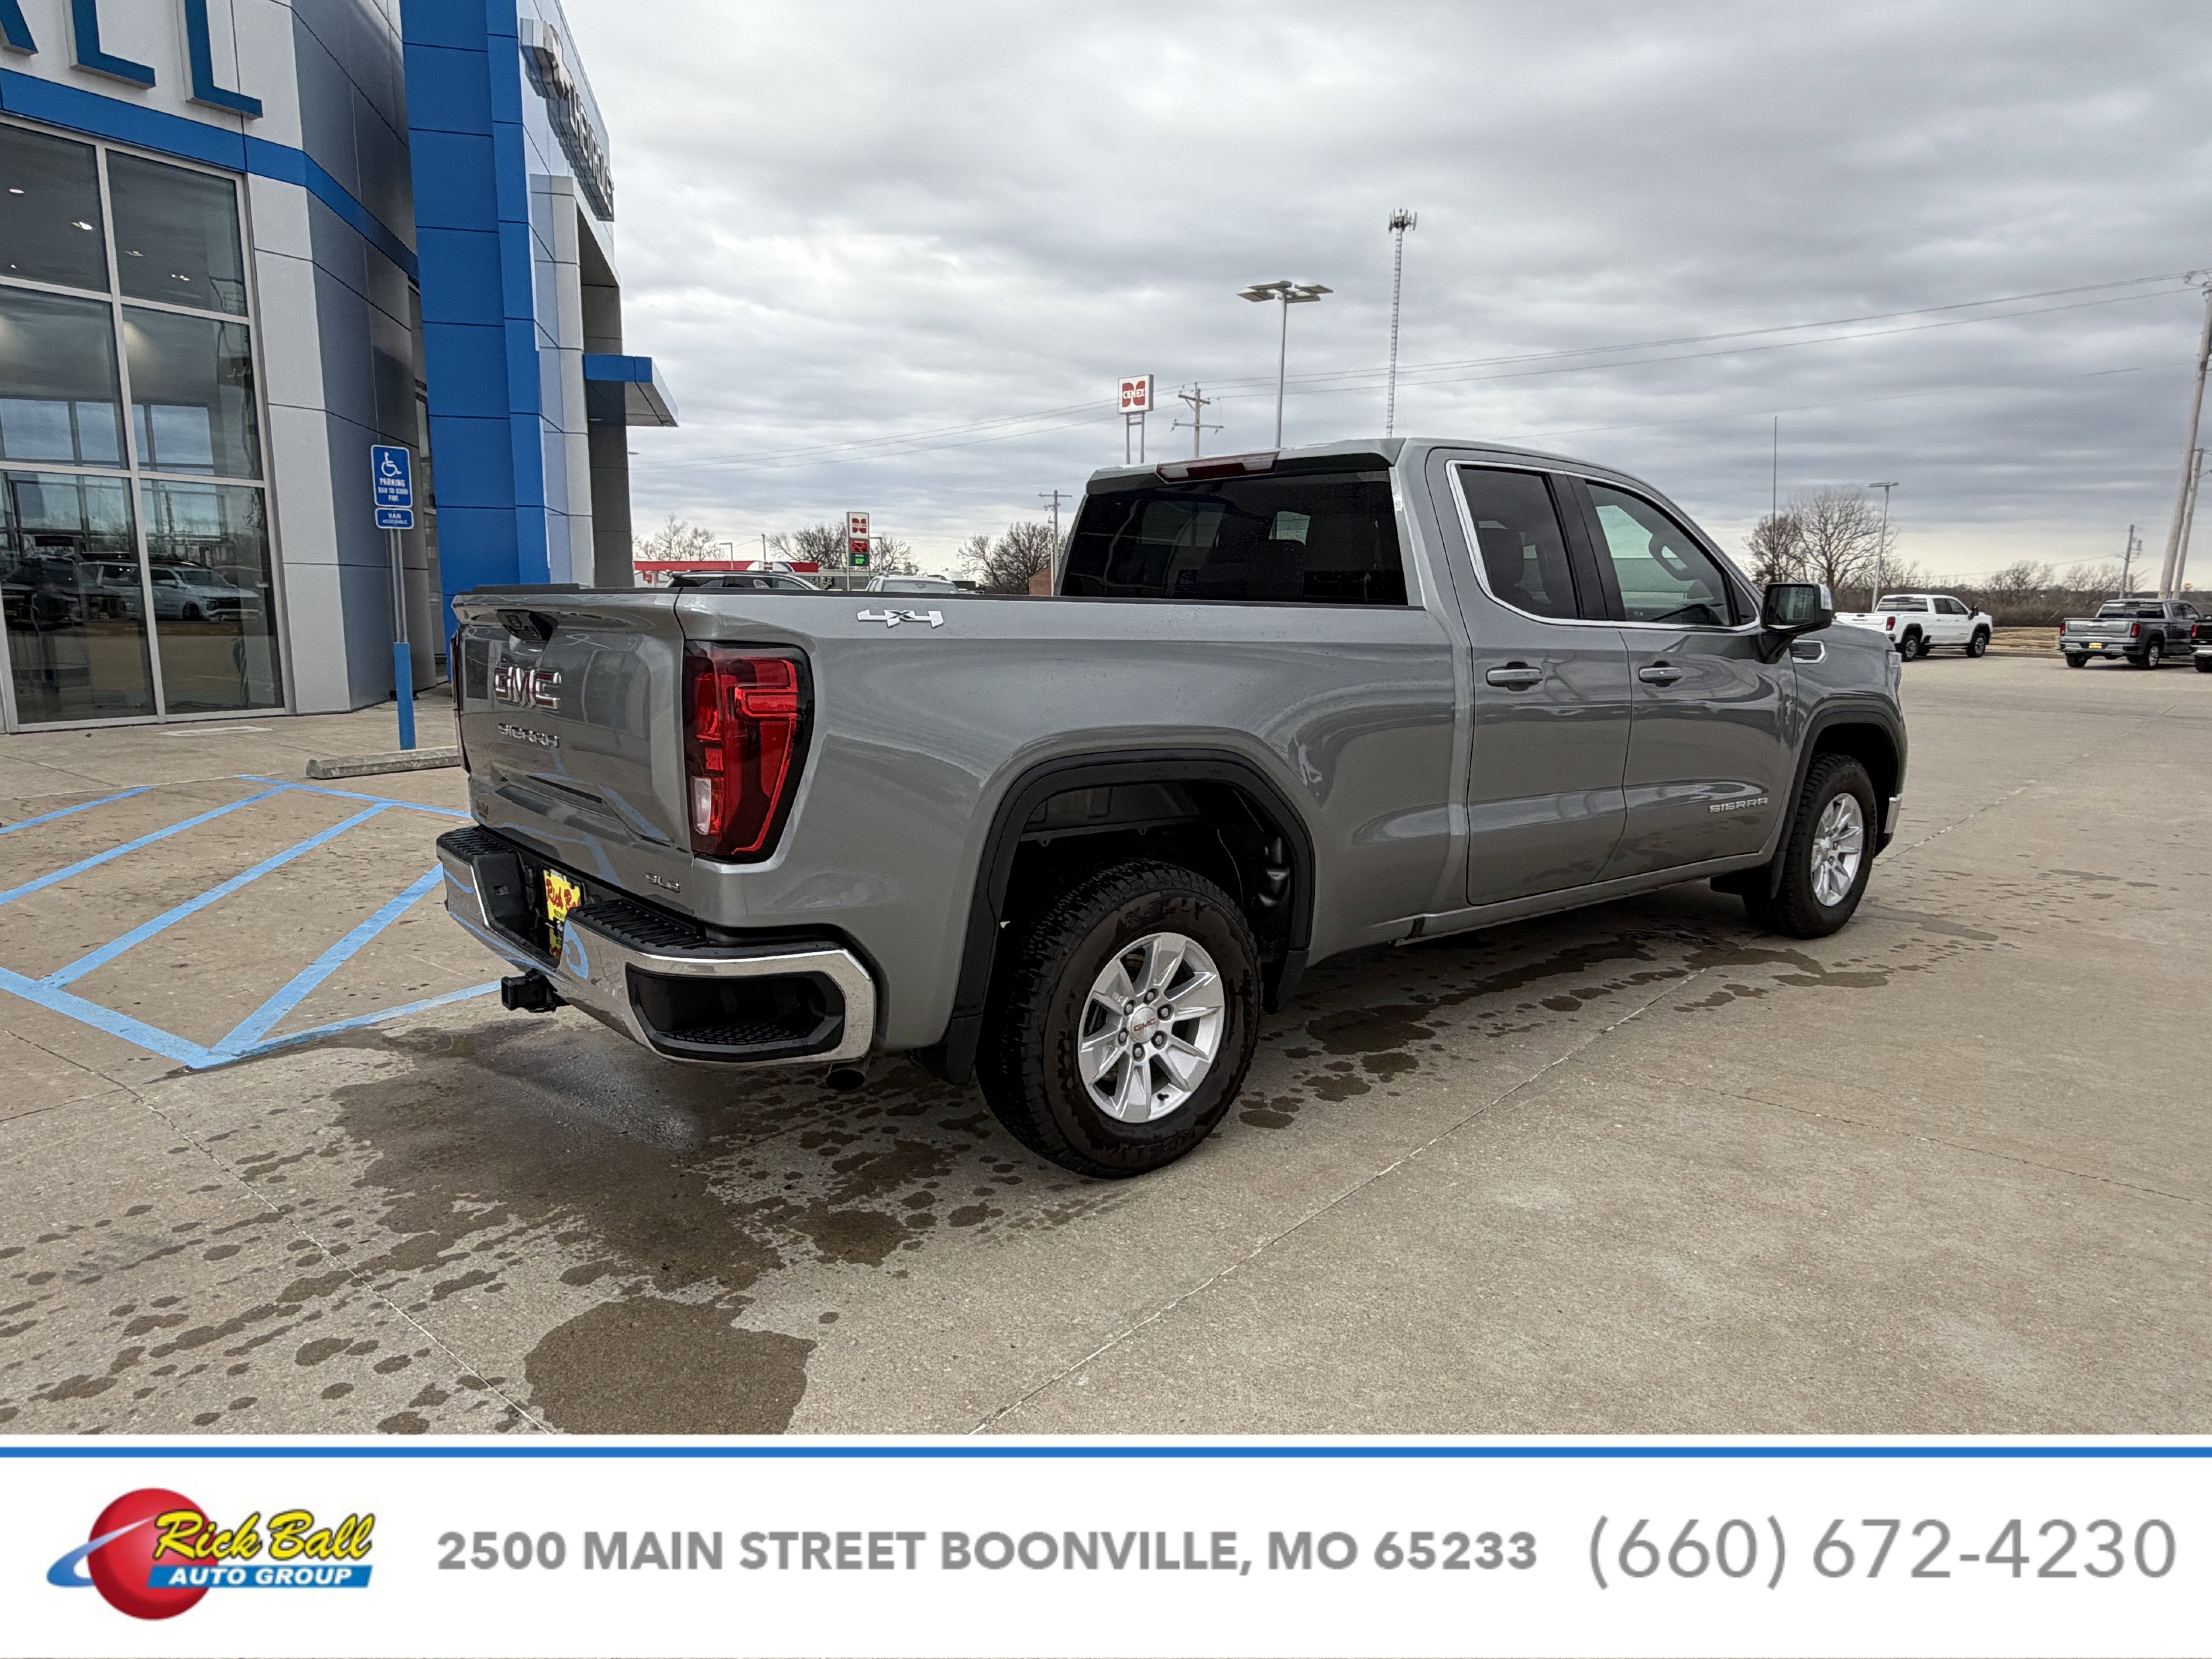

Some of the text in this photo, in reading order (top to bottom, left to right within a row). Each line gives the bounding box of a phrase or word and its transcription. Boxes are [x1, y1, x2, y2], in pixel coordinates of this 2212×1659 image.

[380, 477, 405, 487] PARKING
[493, 666, 562, 710] GMC
[1709, 797, 1768, 813] SIERRA
[1134, 1018, 1156, 1031] GMC
